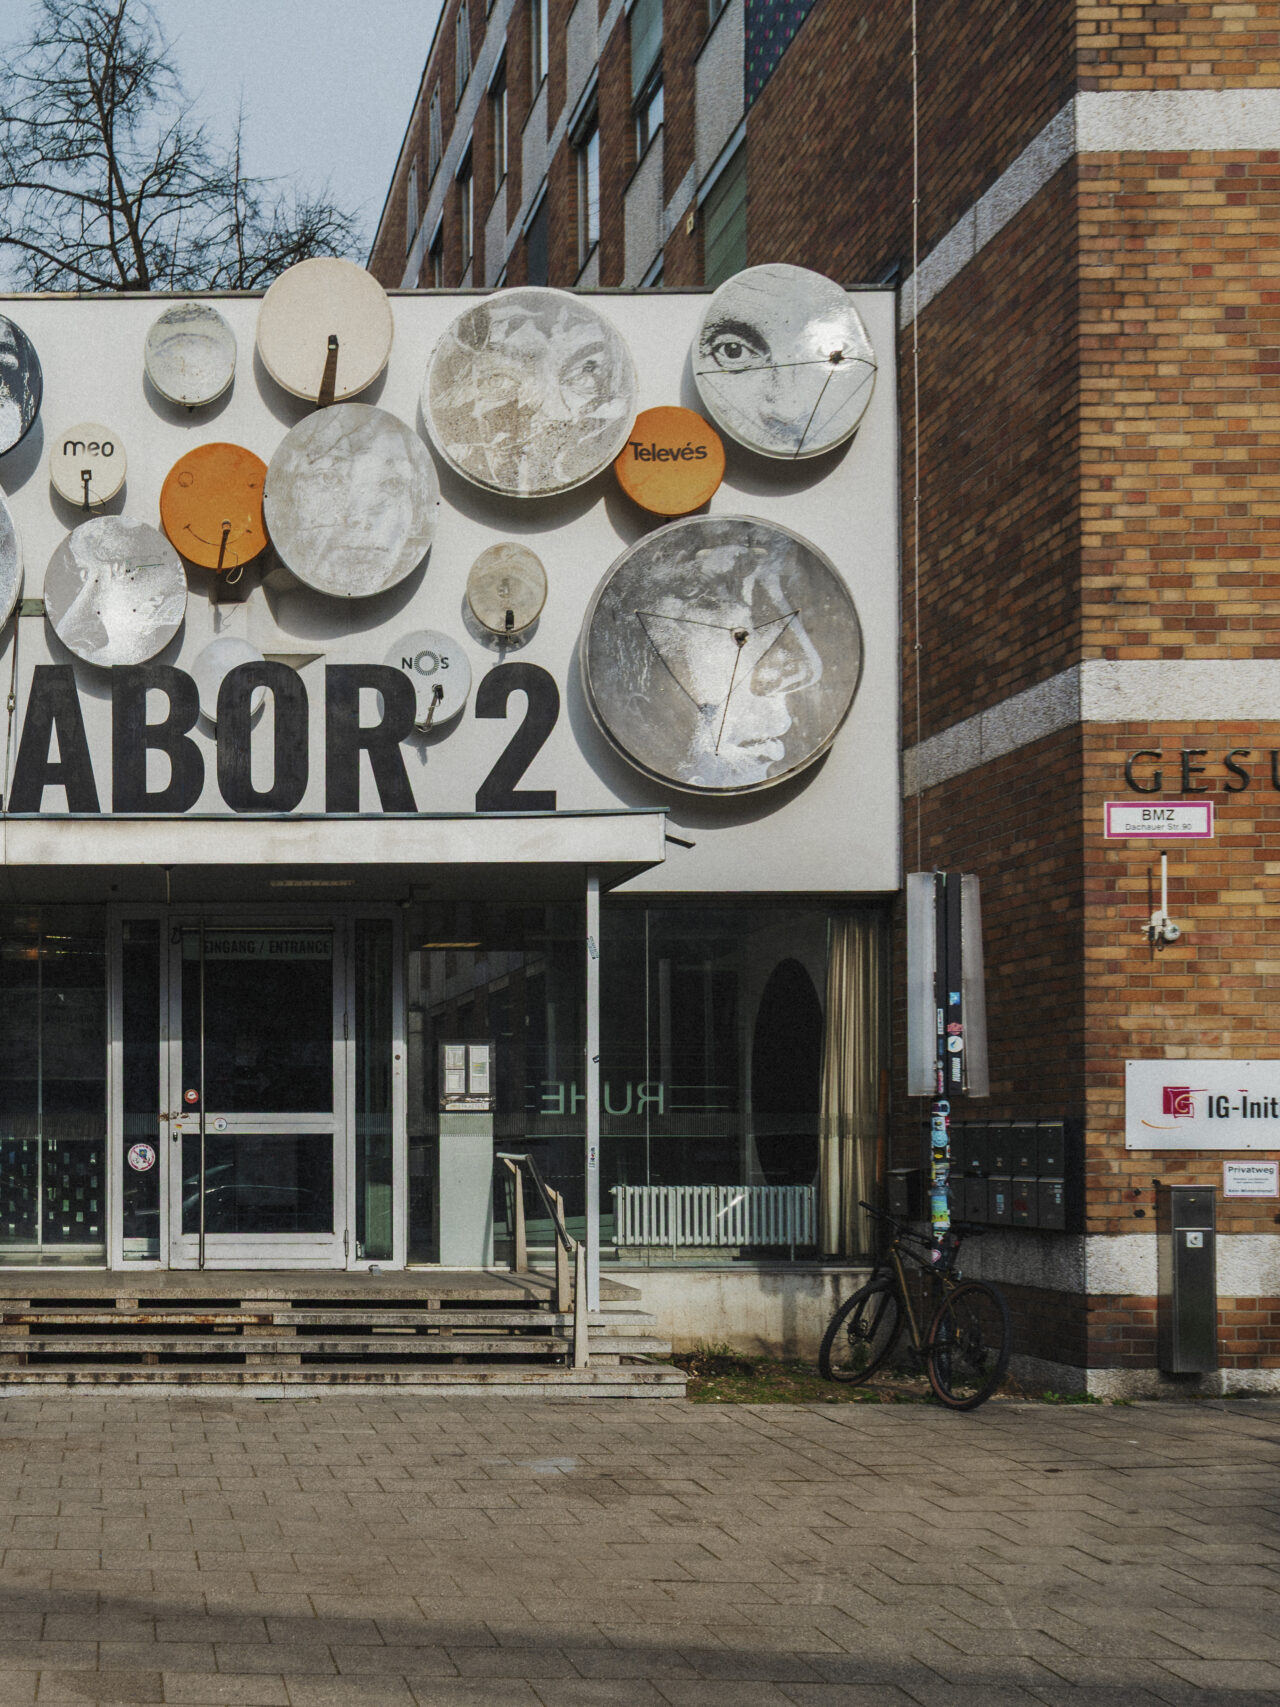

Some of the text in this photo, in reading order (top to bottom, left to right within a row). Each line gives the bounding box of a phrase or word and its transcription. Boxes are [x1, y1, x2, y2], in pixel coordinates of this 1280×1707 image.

[64, 441, 114, 457] meo
[629, 441, 707, 462] Televés
[401, 650, 449, 676] NOS
[475, 662, 560, 815] 2
[1142, 809, 1175, 820] BMZ
[269, 940, 329, 954] ENTRANCE
[1208, 1095, 1279, 1119] IG-Init
[1228, 1166, 1274, 1174] Privatweg
